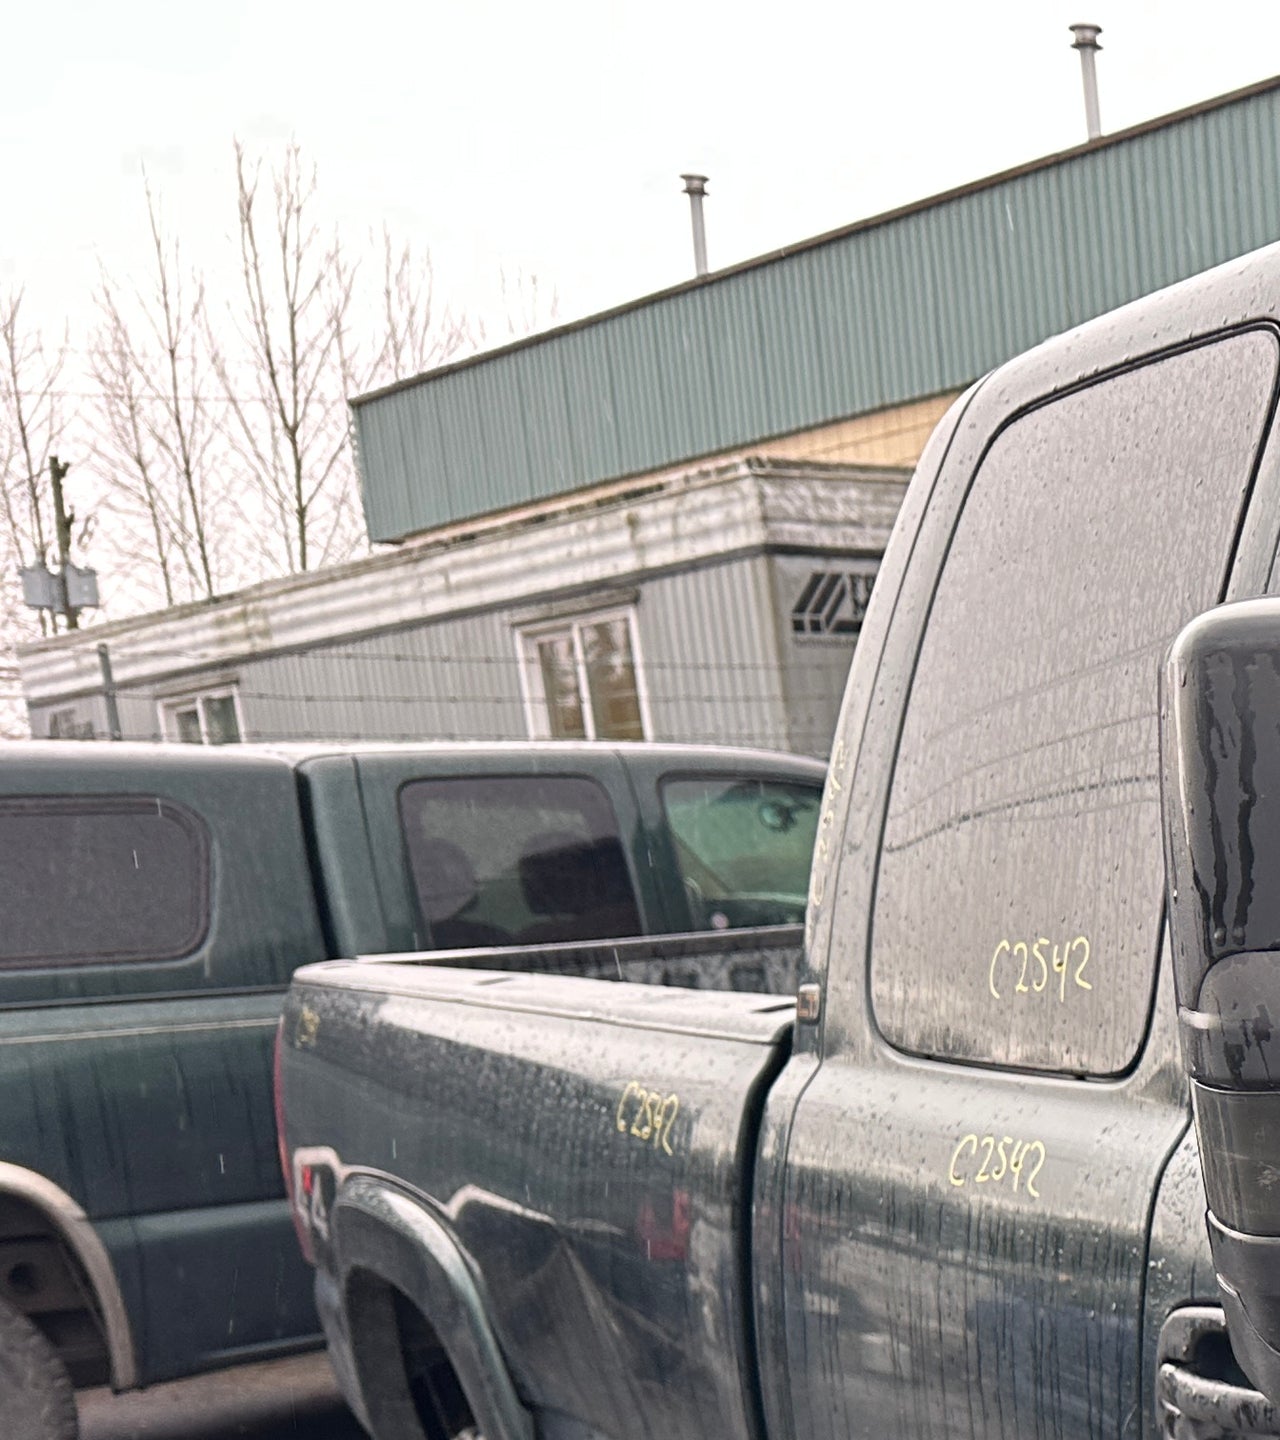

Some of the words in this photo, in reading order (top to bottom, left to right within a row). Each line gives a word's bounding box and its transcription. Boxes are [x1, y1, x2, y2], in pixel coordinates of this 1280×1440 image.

[989, 935, 1092, 1003] C2542
[616, 1080, 680, 1157] C2542
[949, 1133, 1046, 1198] C2542
